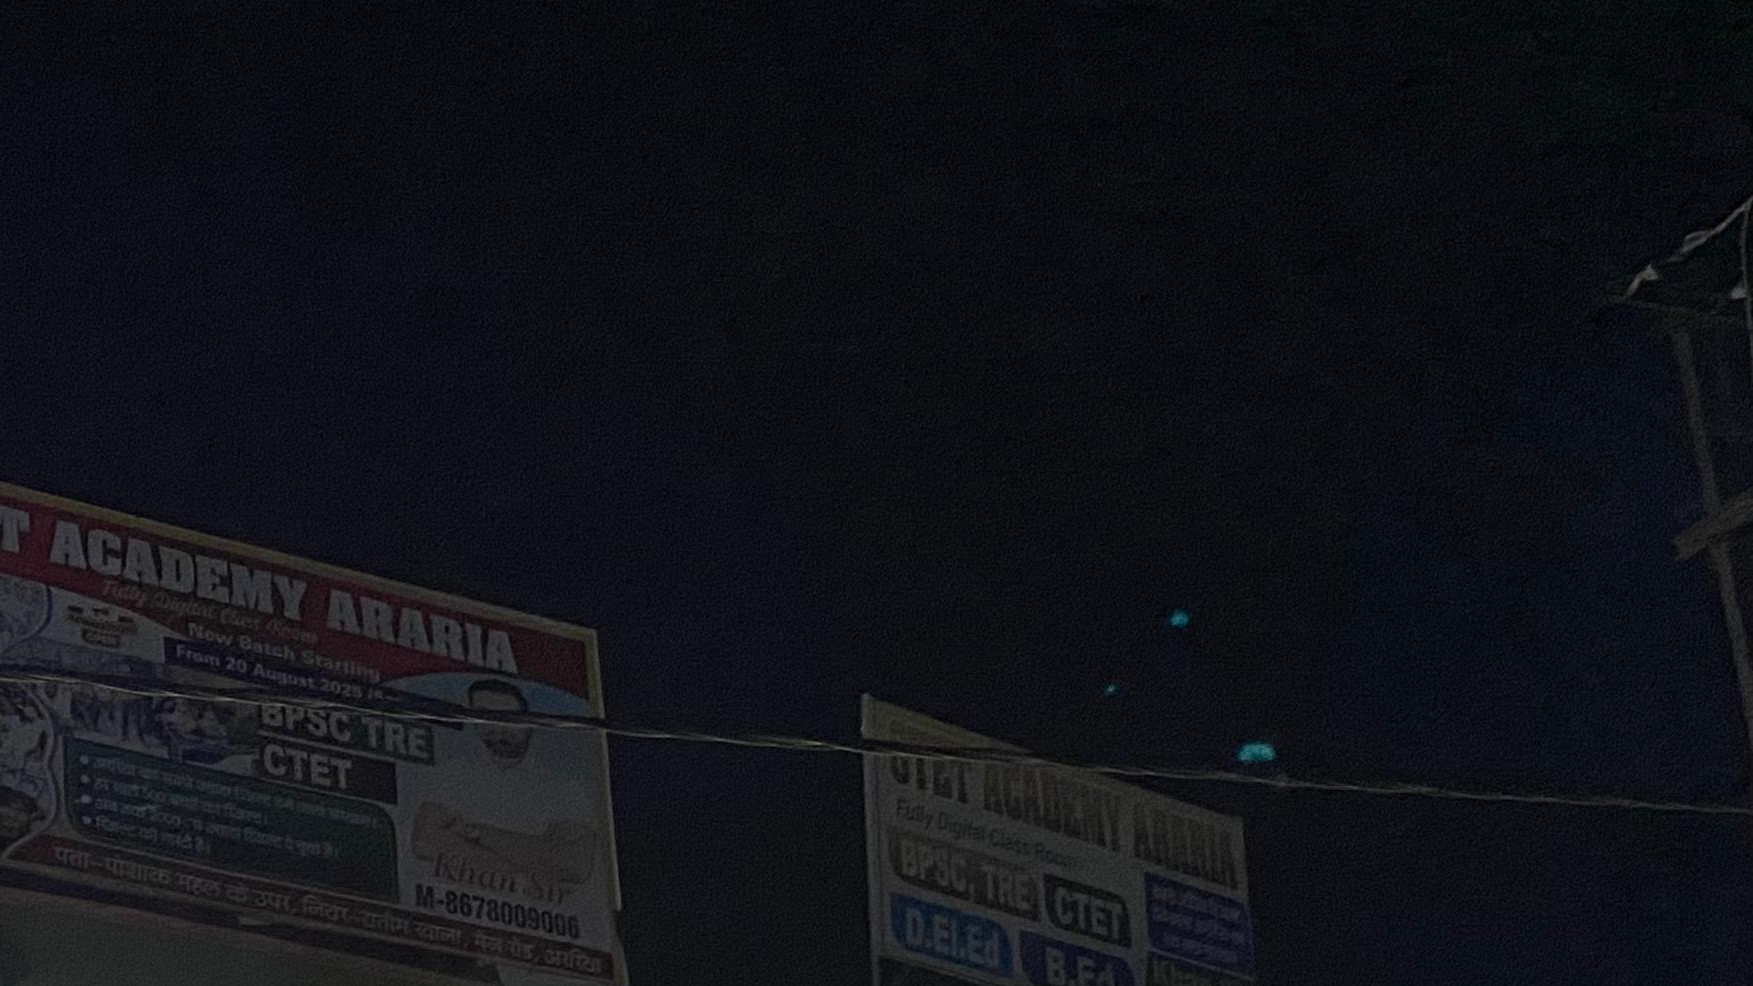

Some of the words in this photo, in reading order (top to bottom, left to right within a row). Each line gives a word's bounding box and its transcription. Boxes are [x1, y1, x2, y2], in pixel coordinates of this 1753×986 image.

[50, 518, 308, 621] ACADEMY
[327, 589, 518, 675] ARARIA
[176, 643, 221, 666] From
[225, 655, 248, 673] 20
[252, 662, 315, 688] August
[188, 621, 235, 646] New
[239, 634, 296, 661] Batch
[300, 648, 382, 684] Starting
[259, 704, 352, 743] BPSC
[359, 715, 430, 759] TRE
[262, 743, 353, 791] CTET
[432, 852, 518, 894] Khan
[1053, 886, 1127, 941] CTET
